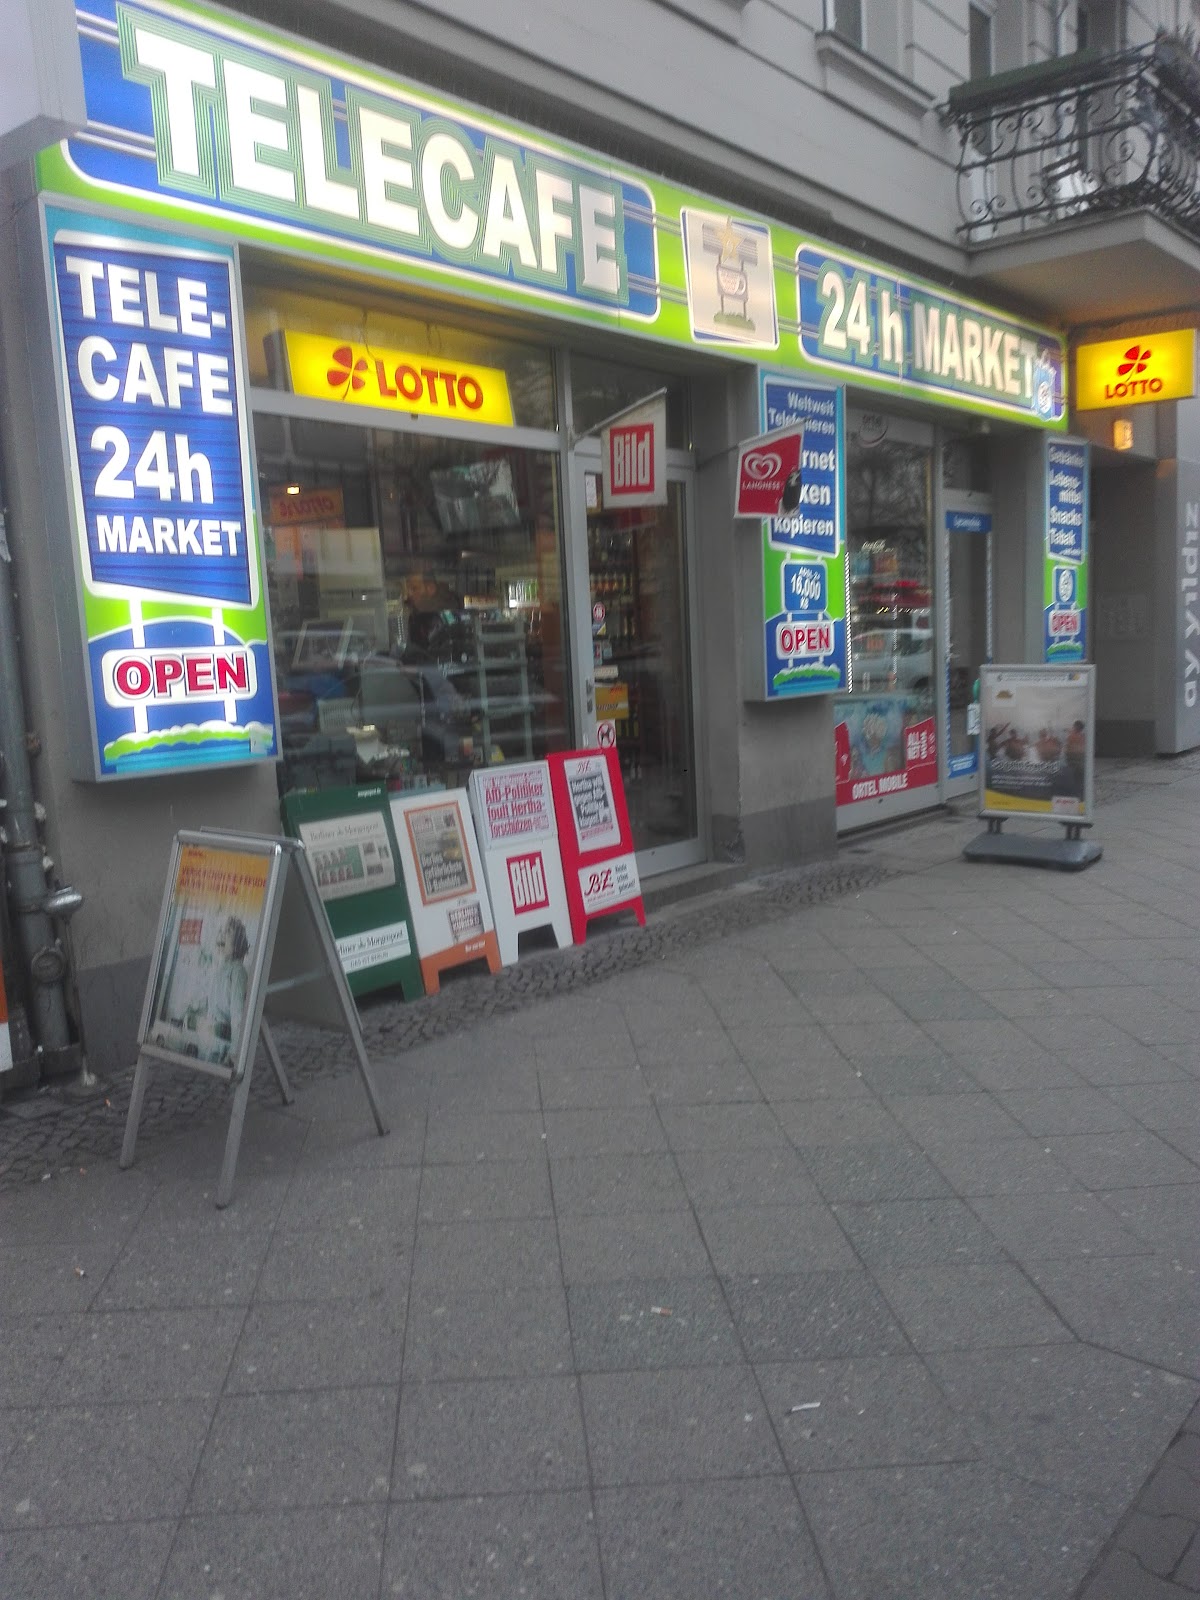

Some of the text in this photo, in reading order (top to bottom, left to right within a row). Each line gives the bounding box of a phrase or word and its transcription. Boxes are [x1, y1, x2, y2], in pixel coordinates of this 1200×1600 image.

[133, 29, 621, 296] TELECAFE
[822, 271, 871, 355] 24
[881, 289, 904, 364] h
[913, 300, 1036, 399] MARKET
[76, 336, 234, 416] CAFE
[376, 366, 485, 411] LOTTO
[1105, 377, 1163, 399] LOTTO
[788, 392, 835, 416] Weltweit
[89, 425, 213, 505] 24h
[613, 431, 650, 487] Bild
[95, 513, 242, 558] MARKET
[781, 627, 831, 652] OPEN
[113, 654, 248, 700] OPEN
[852, 780, 878, 800] ORTEL
[510, 857, 546, 908] Bild
